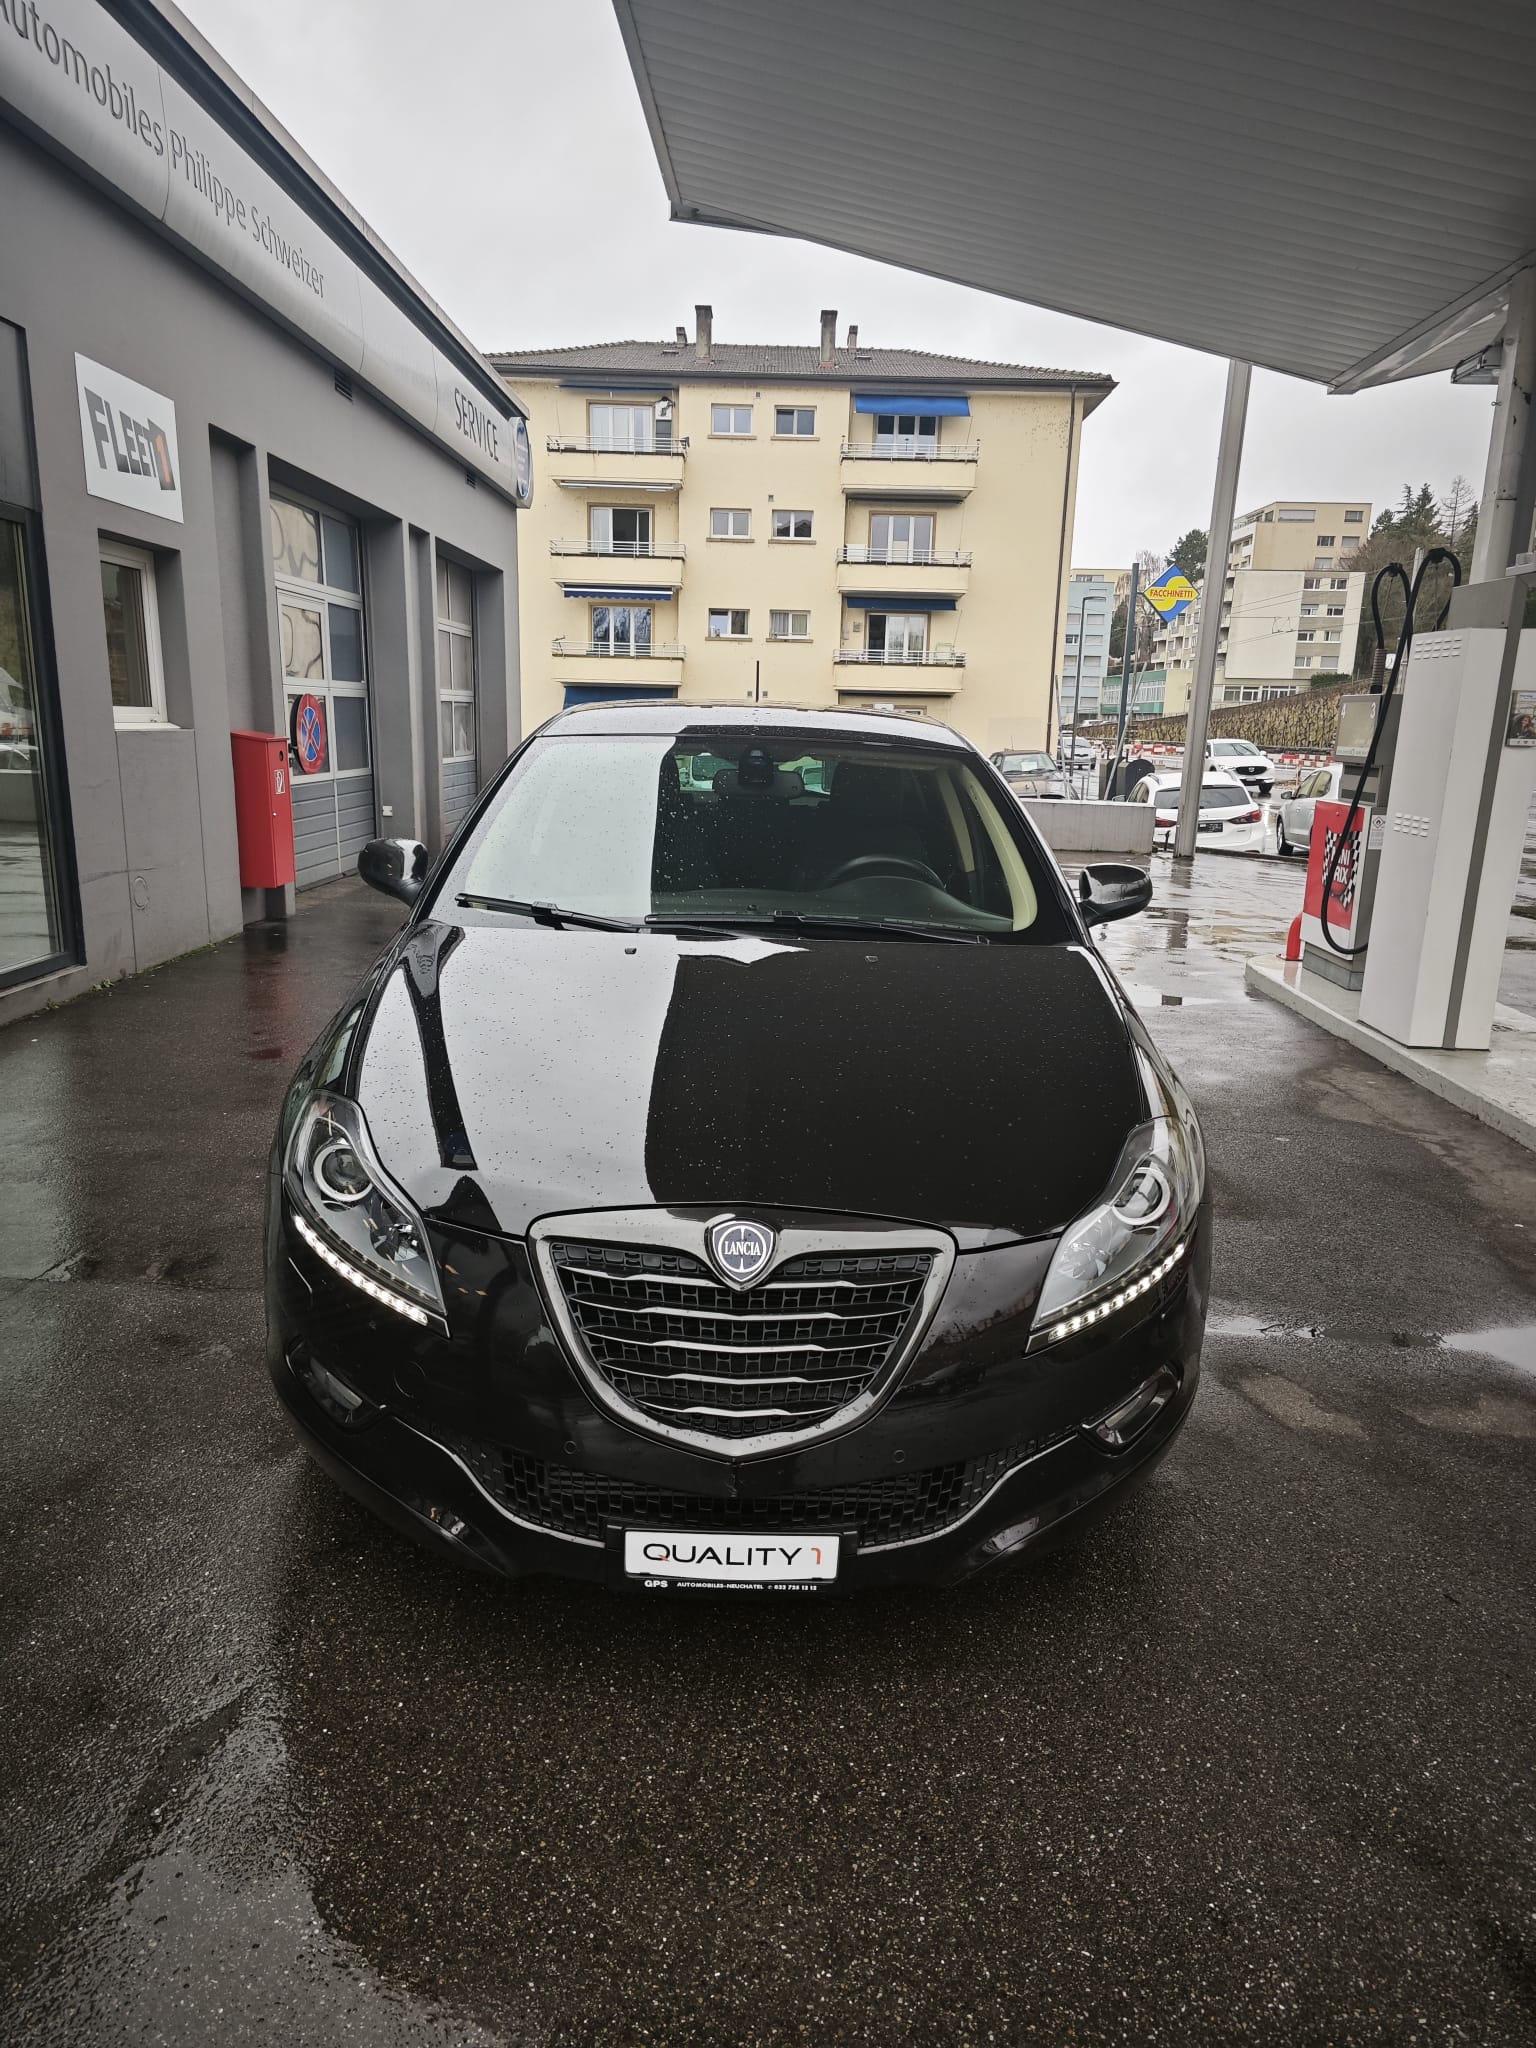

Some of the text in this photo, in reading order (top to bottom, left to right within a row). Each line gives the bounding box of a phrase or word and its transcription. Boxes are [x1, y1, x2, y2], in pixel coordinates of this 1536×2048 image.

[169, 129, 247, 230] Philippe
[251, 205, 324, 298] Schweizer
[454, 387, 499, 462] SERVICE
[1150, 589, 1193, 598] FACCHINETTI
[1340, 703, 1347, 719] 4
[1369, 701, 1377, 719] 3
[724, 1240, 762, 1256] LANCIA
[643, 1543, 821, 1566] QUALITY 1
[644, 1580, 668, 1588] GPS
